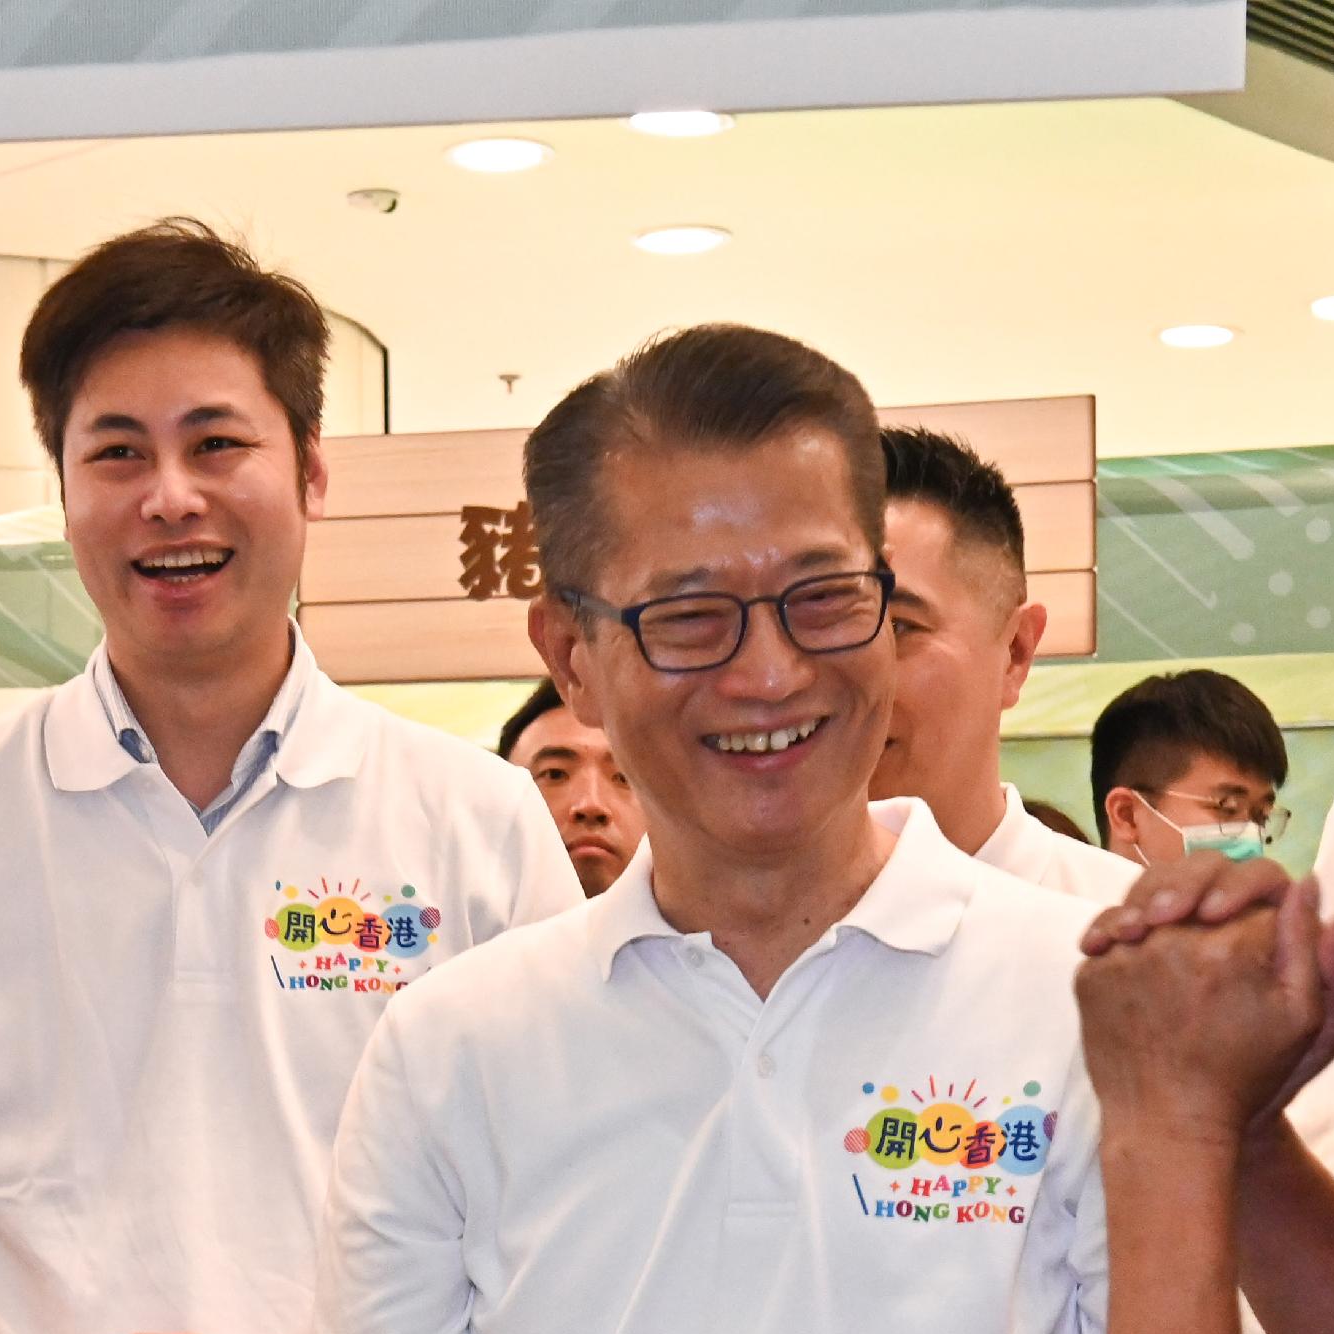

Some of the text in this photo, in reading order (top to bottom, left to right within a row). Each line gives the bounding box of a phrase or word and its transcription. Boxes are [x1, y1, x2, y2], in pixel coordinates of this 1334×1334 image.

[284, 908, 418, 949] 開心香港
[315, 952, 388, 973] HAPPY
[289, 975, 348, 991] HONG
[875, 1116, 1041, 1165] 開心香港
[910, 1174, 1002, 1198] HAPPY
[875, 1200, 1025, 1224] HONG KONG
